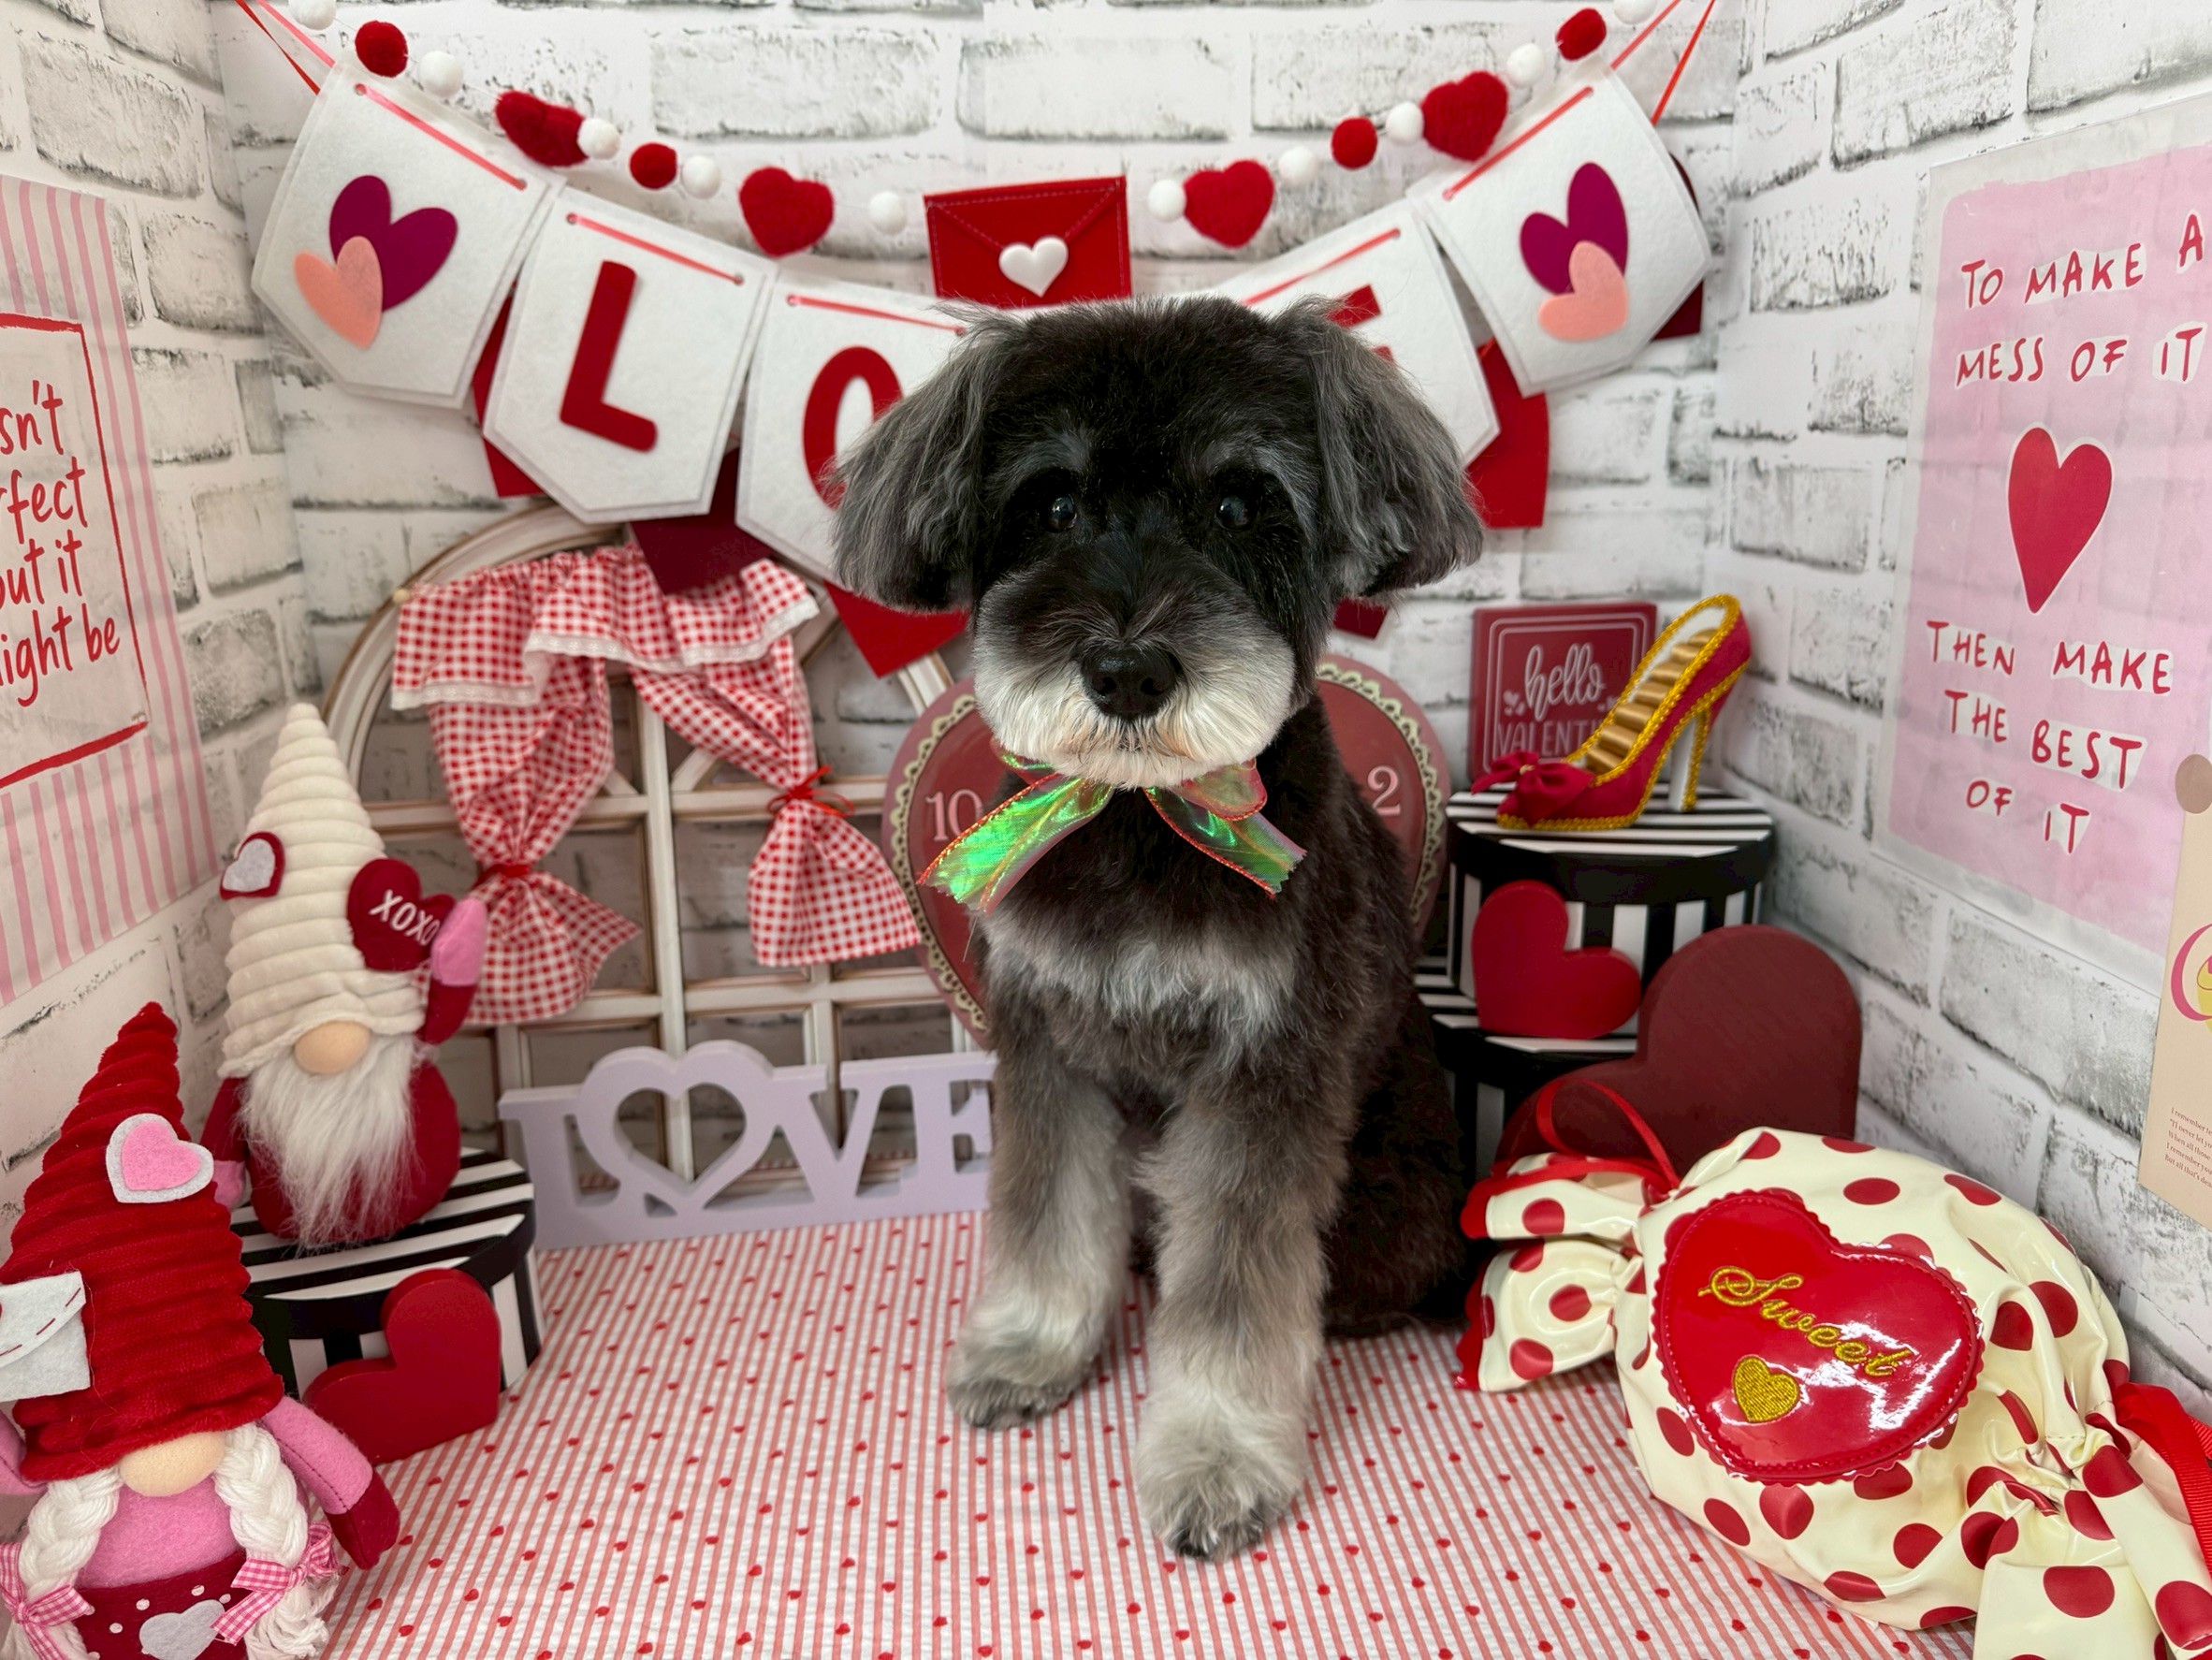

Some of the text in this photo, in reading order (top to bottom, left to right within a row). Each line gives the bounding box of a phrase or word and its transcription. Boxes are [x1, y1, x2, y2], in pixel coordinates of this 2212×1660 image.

[1961, 213, 2204, 309] TO MAKE A
[1956, 327, 2204, 387] MESS OF IT
[55, 529, 82, 597] it
[0, 603, 120, 707] ight be
[1524, 642, 1607, 722] hello
[1927, 620, 2171, 694] THEN MAKE
[1943, 689, 2143, 789] THE BEST
[925, 789, 983, 840] 10
[1367, 765, 1401, 816] 2
[1966, 779, 2090, 854] OF IT
[368, 889, 441, 946] XOXO
[2168, 1130, 2211, 1161] When all those
[2175, 1111, 2205, 1132] remember
[2178, 1126, 2195, 1139] never
[2170, 1145, 2201, 1167] remember
[2176, 1160, 2184, 1171] all
[1697, 1266, 1914, 1377] Sweet
